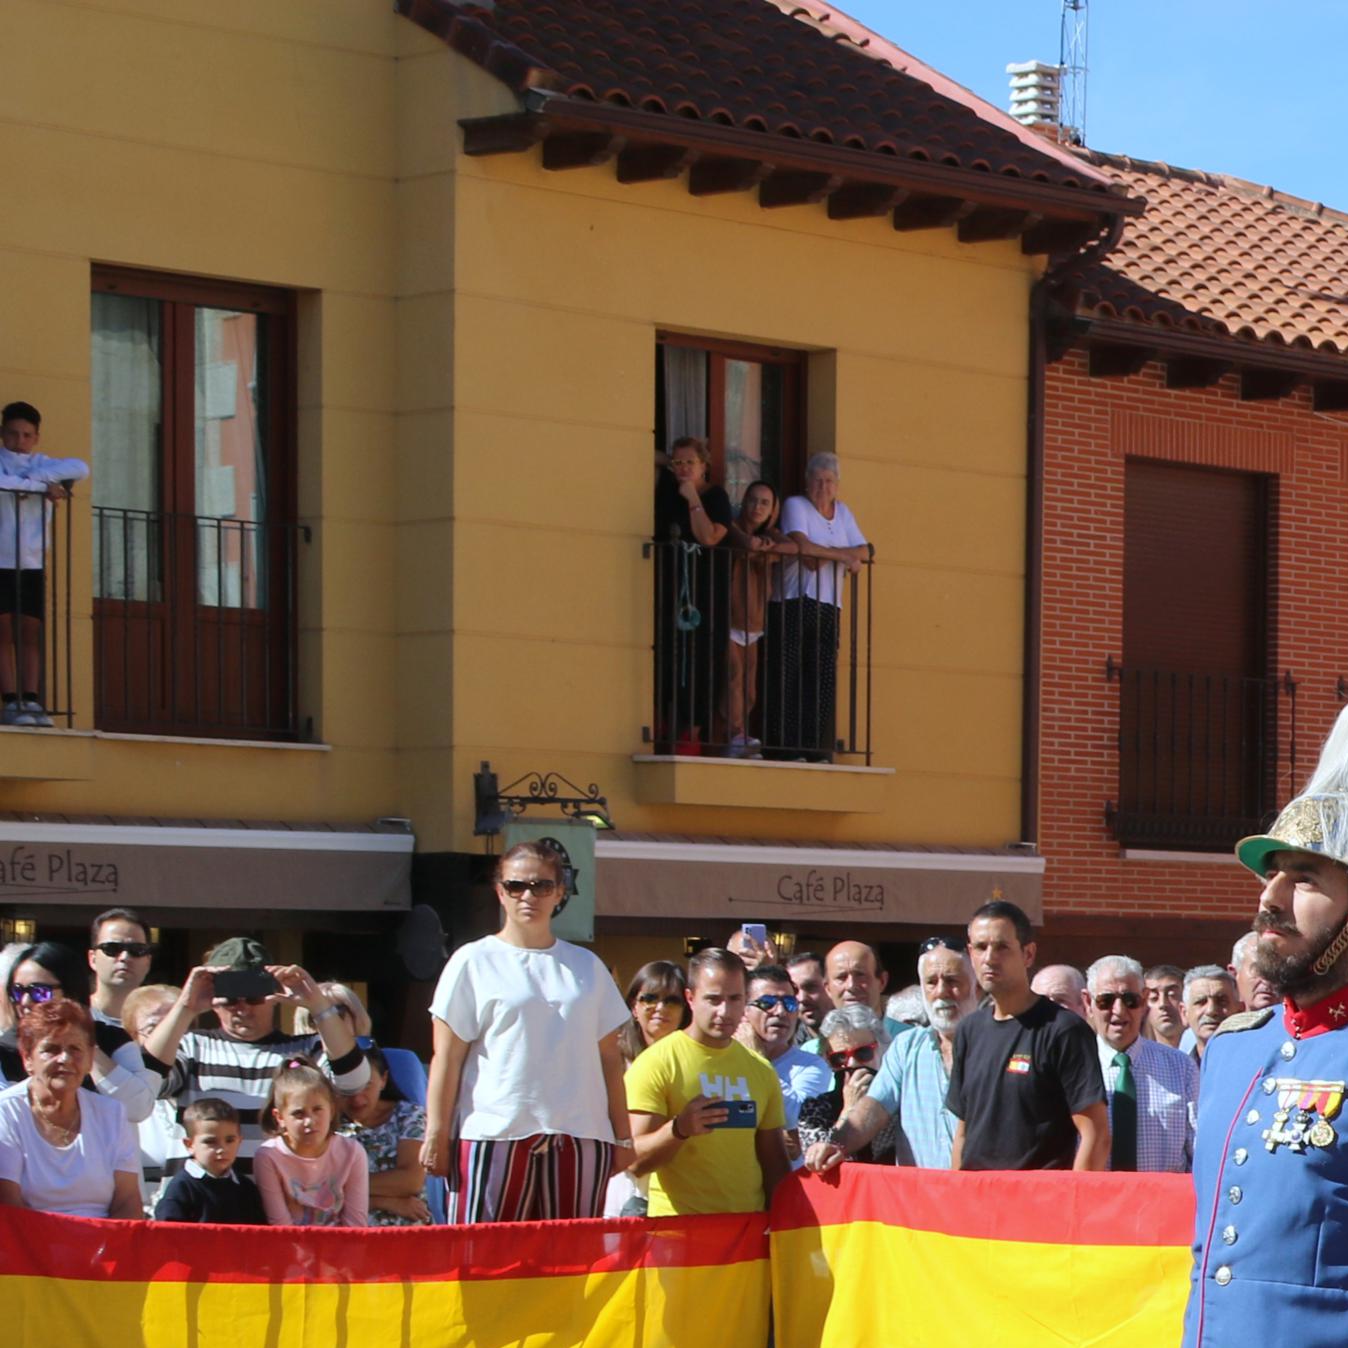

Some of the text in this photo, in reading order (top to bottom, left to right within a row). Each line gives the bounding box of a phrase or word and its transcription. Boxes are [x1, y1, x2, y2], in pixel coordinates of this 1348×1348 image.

[0, 846, 119, 888] afé Plaza
[777, 869, 885, 906] Café Plaza
